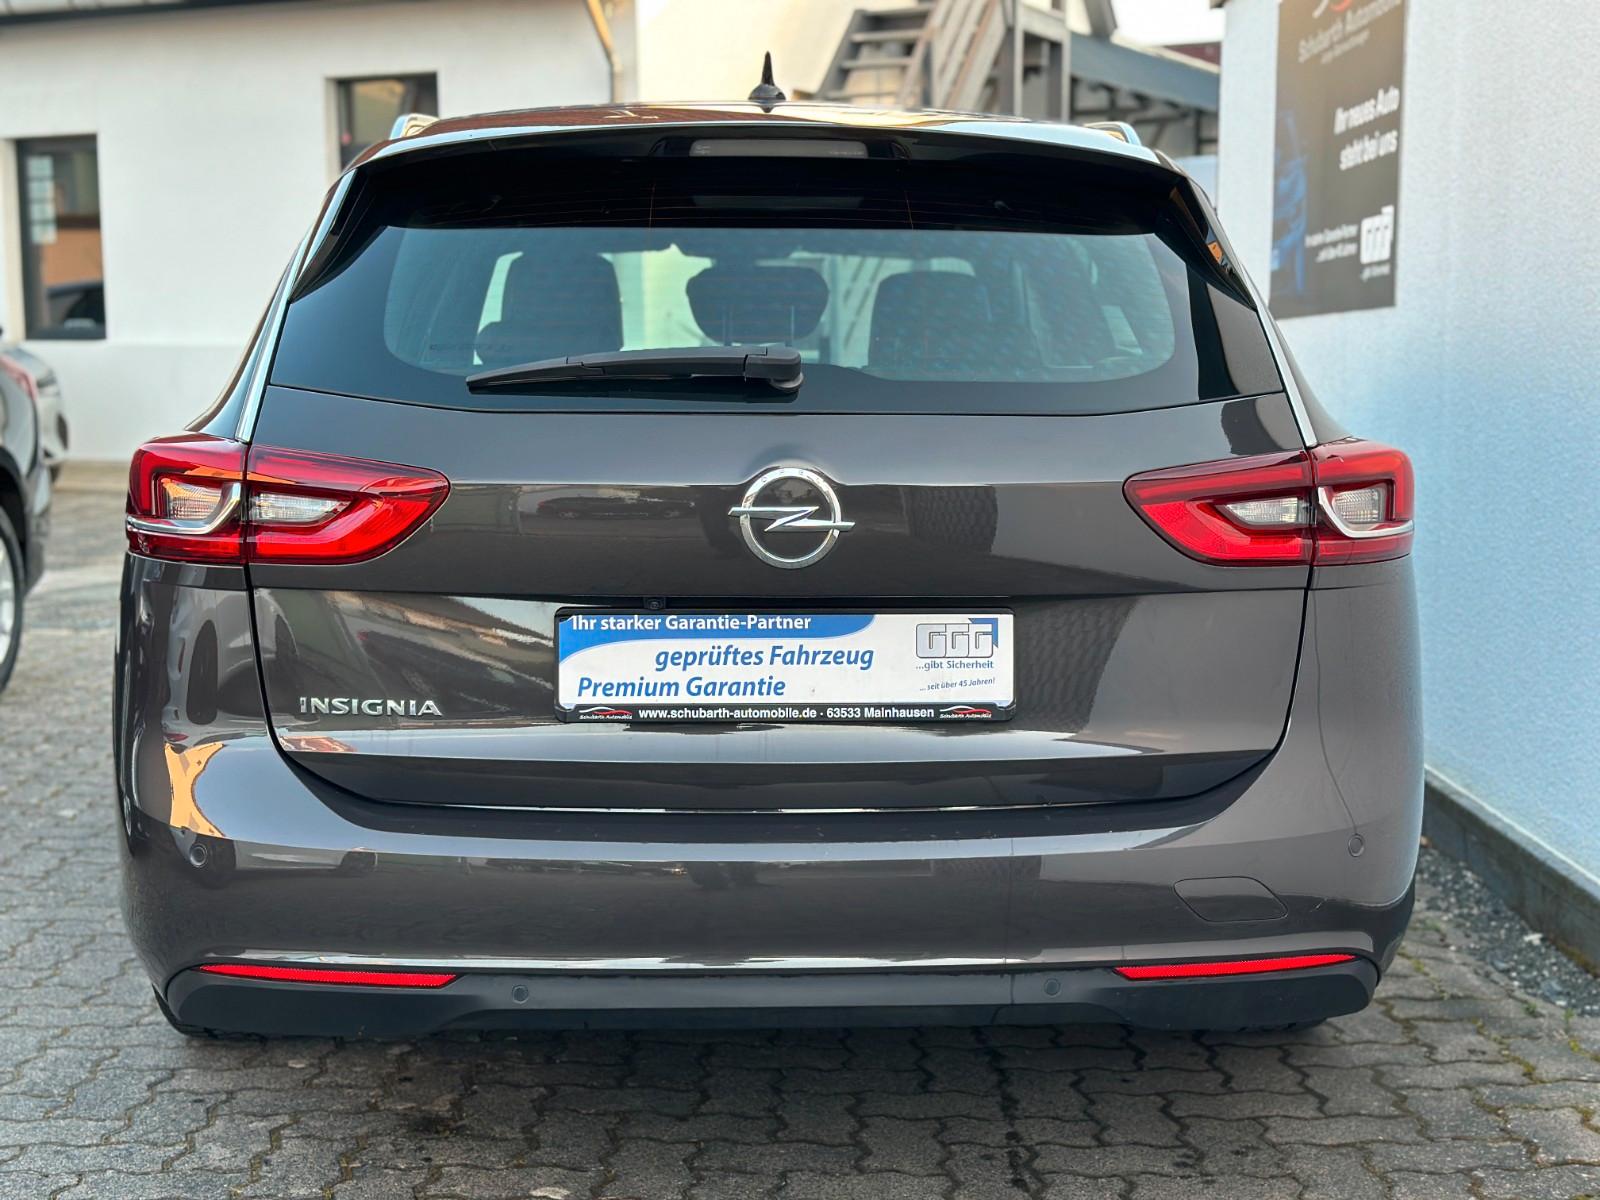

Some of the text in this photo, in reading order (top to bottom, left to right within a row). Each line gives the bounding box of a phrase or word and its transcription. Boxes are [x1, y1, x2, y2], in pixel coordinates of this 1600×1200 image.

[1376, 85, 1400, 117] Auto
[572, 615, 811, 631] Ihr starker Garantie-Partner
[655, 645, 874, 671] geprüftes Fahrzeug
[946, 660, 994, 669] Sicherheit
[578, 676, 786, 697] Premium Garantie
[940, 681, 957, 689] über
[958, 679, 967, 687] 45
[299, 697, 443, 716] INSIGNIA
[639, 707, 817, 719] www.schubarth-automobile.de
[826, 708, 861, 718] 63533
[864, 707, 935, 718] Mainhausen
